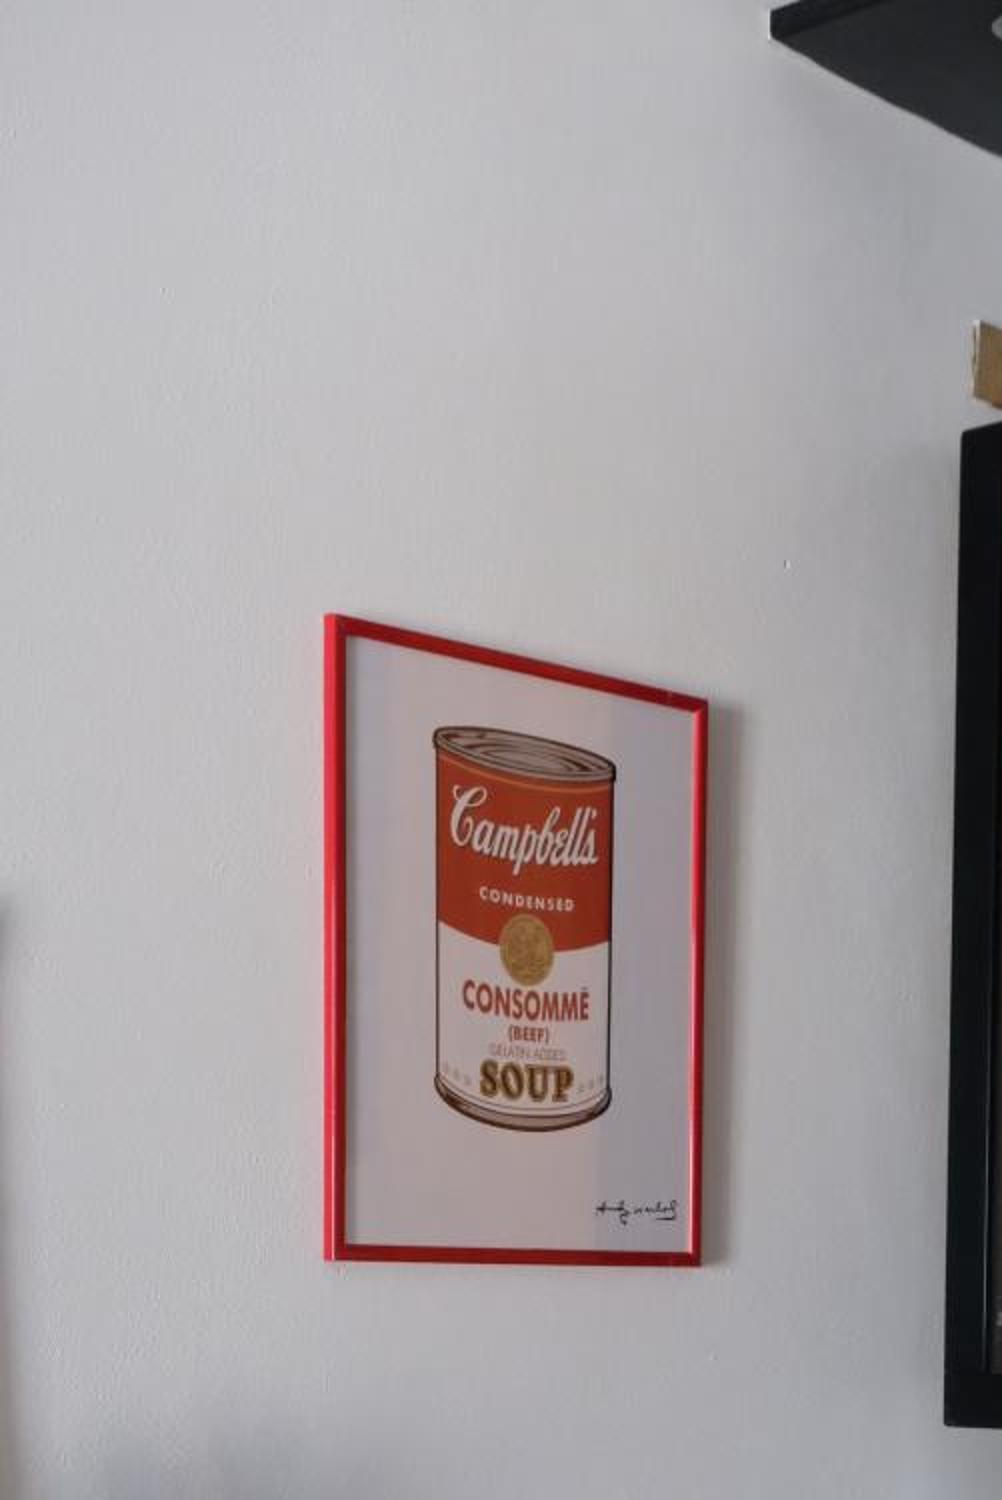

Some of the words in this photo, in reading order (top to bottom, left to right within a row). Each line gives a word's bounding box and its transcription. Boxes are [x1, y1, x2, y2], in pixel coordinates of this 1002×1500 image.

[450, 785, 598, 876] Campbell's
[479, 886, 575, 912] CONDENSED
[508, 1024, 549, 1044] (BEEF)
[480, 1059, 574, 1102] SOUP
